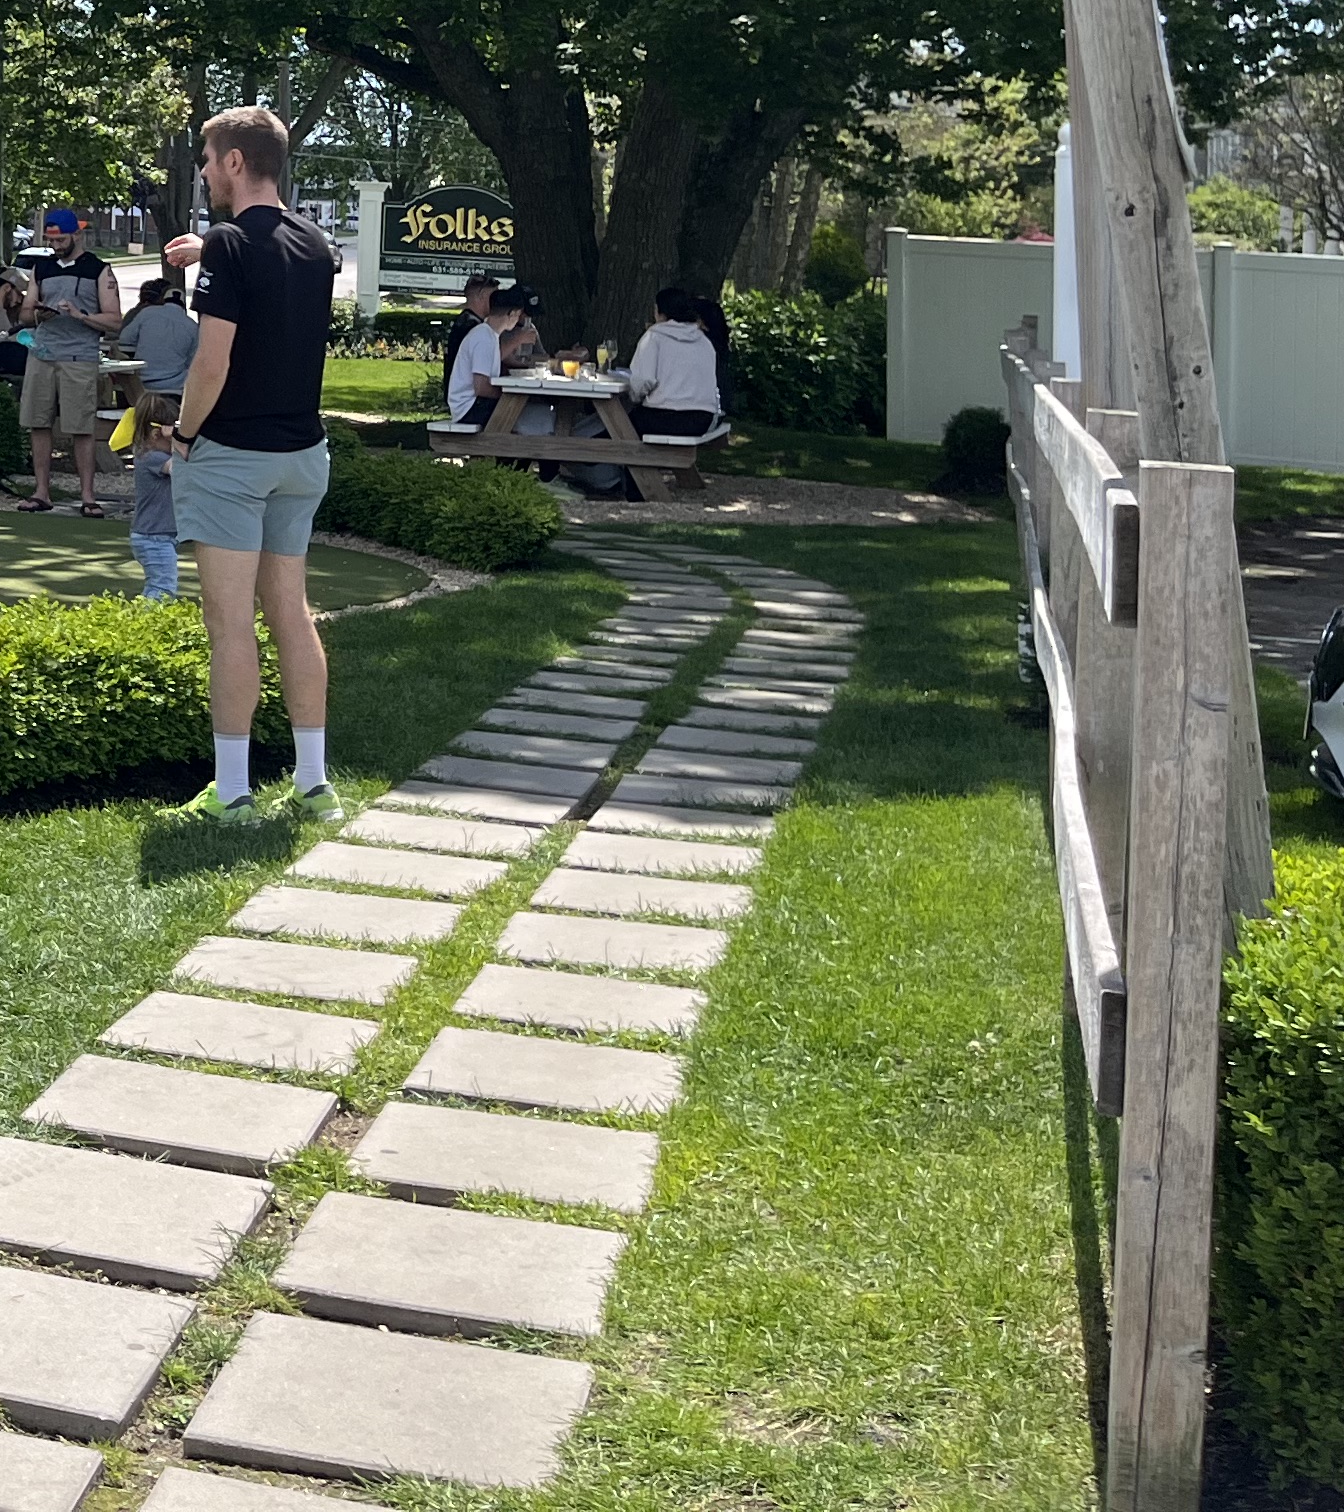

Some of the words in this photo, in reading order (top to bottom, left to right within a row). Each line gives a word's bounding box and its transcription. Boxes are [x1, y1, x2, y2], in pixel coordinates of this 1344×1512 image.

[399, 203, 514, 243] Folks
[418, 240, 481, 254] INSURANCE
[482, 243, 513, 256] GROU
